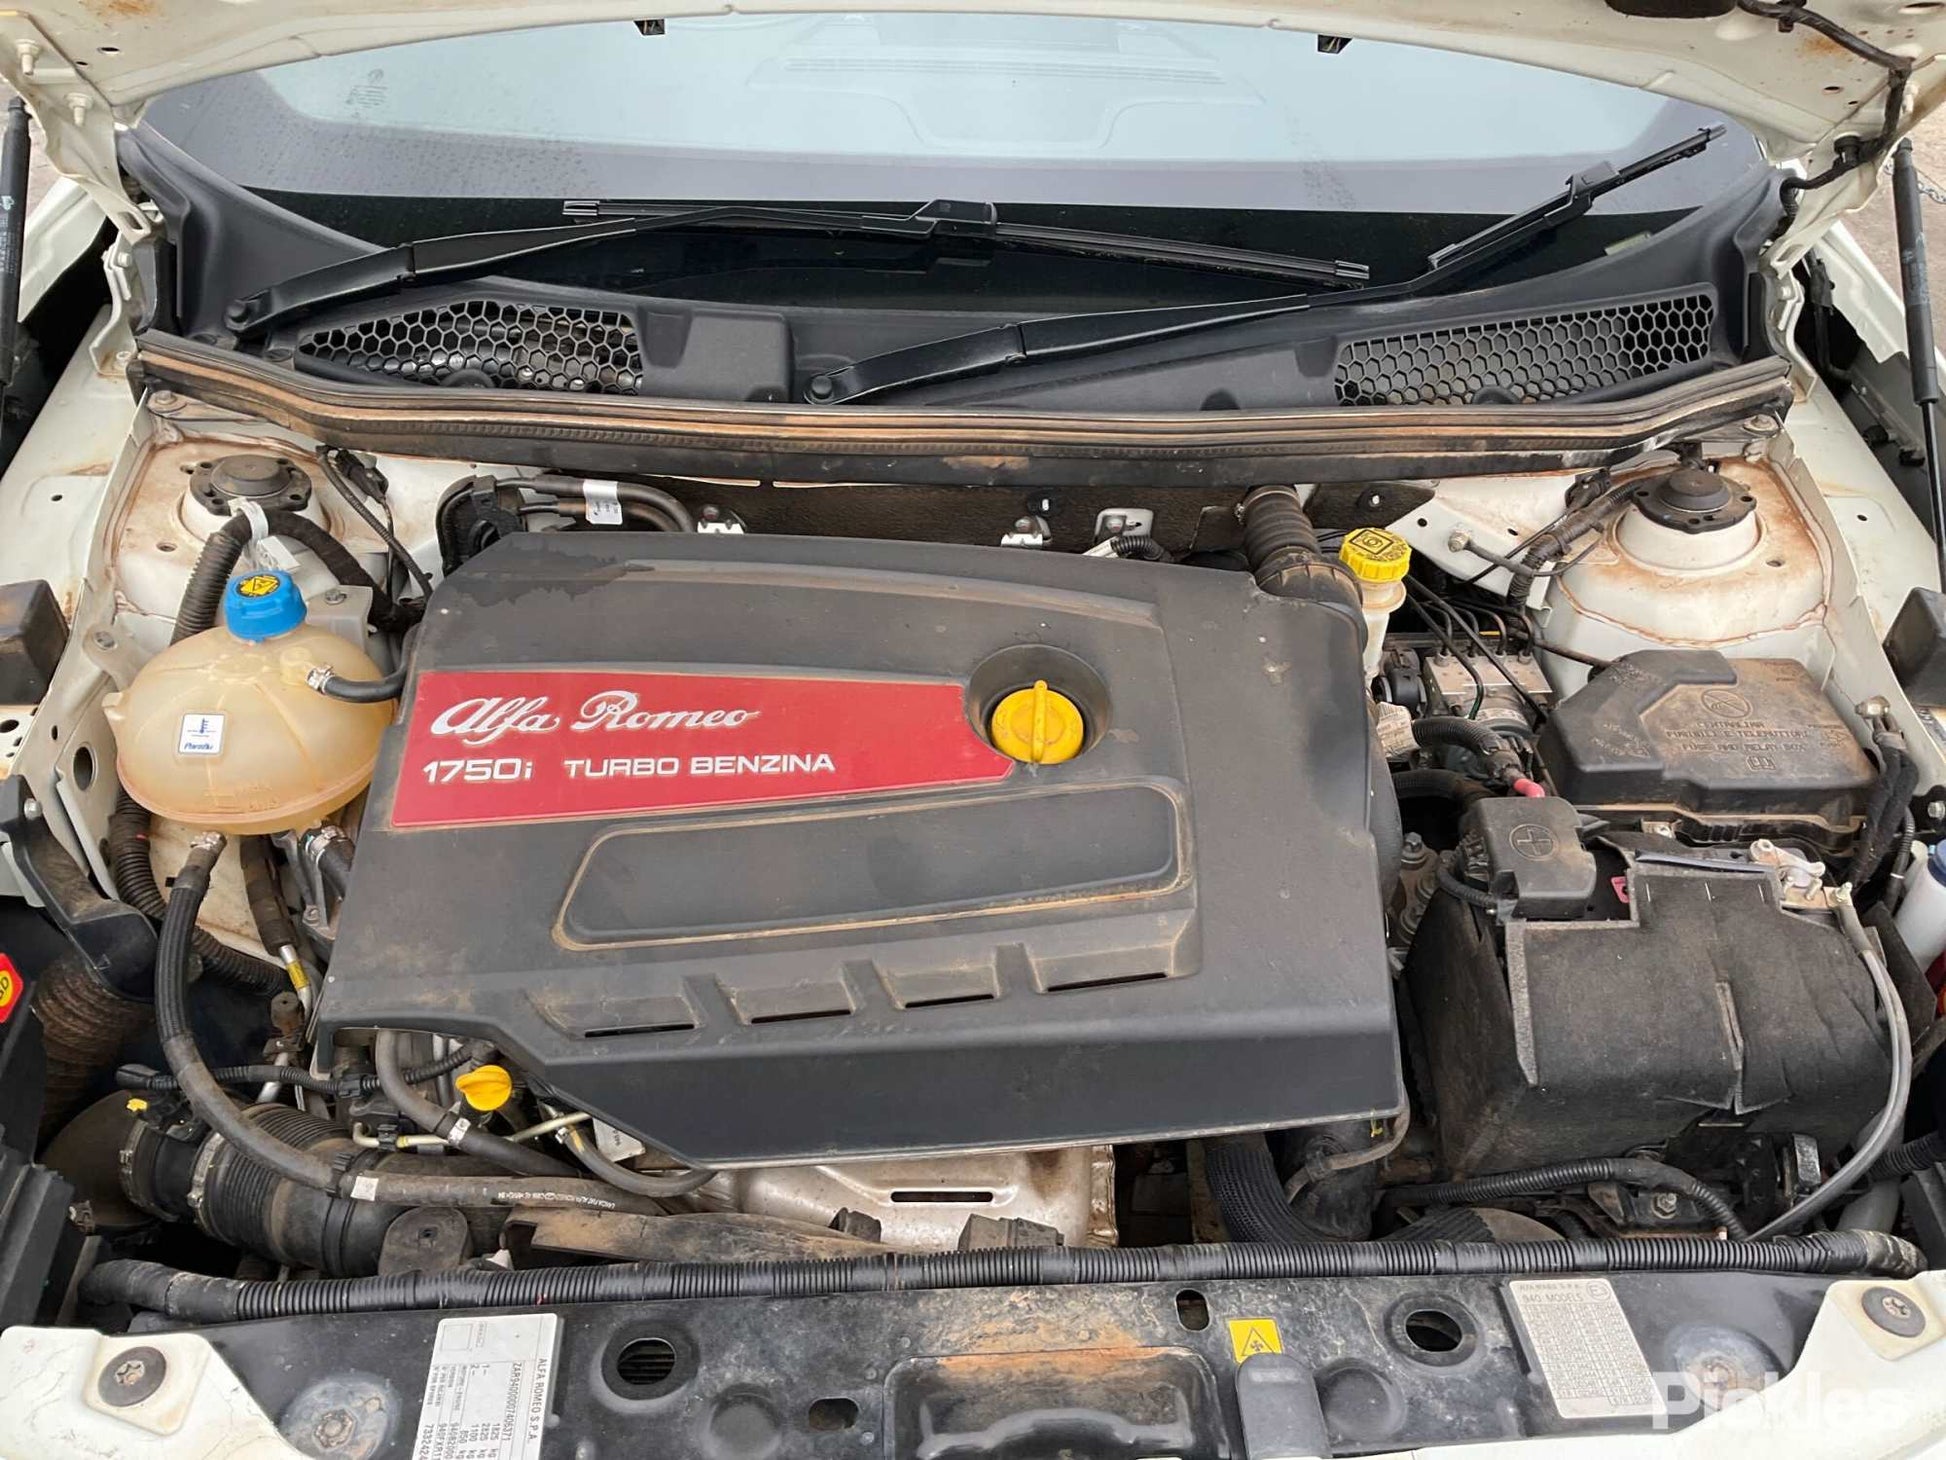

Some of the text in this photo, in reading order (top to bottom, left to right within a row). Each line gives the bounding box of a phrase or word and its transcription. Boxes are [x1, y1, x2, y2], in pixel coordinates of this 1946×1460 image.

[430, 690, 760, 746] Alfa Romeo
[1717, 743, 1738, 751] AND
[1743, 743, 1778, 751] RELAY
[423, 753, 836, 783] 1750i TURBO BENZINA
[1545, 1293, 1584, 1302] MODELS
[536, 1358, 548, 1380] ALFA
[531, 1382, 545, 1414] ROMEO
[469, 1423, 479, 1442] 1100
[466, 1449, 477, 1460] kg
[477, 1449, 488, 1459] kg
[488, 1448, 499, 1459] kg
